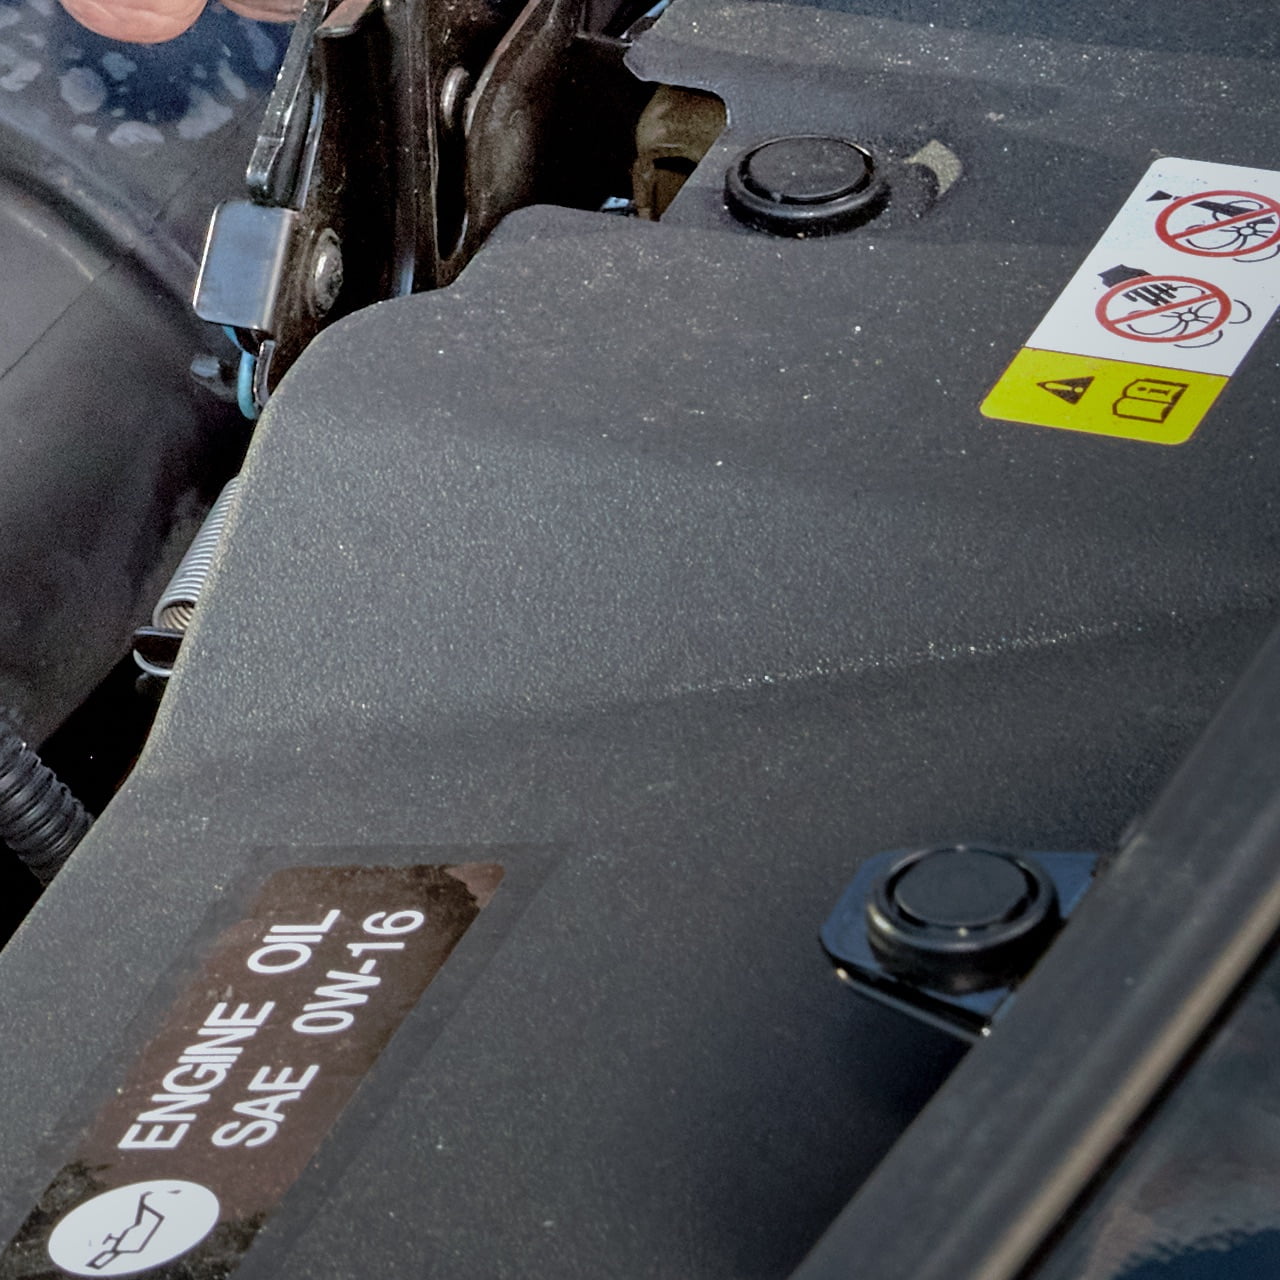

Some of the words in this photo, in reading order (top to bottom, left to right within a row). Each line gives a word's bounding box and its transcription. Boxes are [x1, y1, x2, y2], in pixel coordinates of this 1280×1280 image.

[118, 1000, 276, 1149] ENGINE
[247, 909, 341, 974] OIL
[212, 1064, 320, 1148] SAE
[291, 909, 425, 1035] 0W-16
